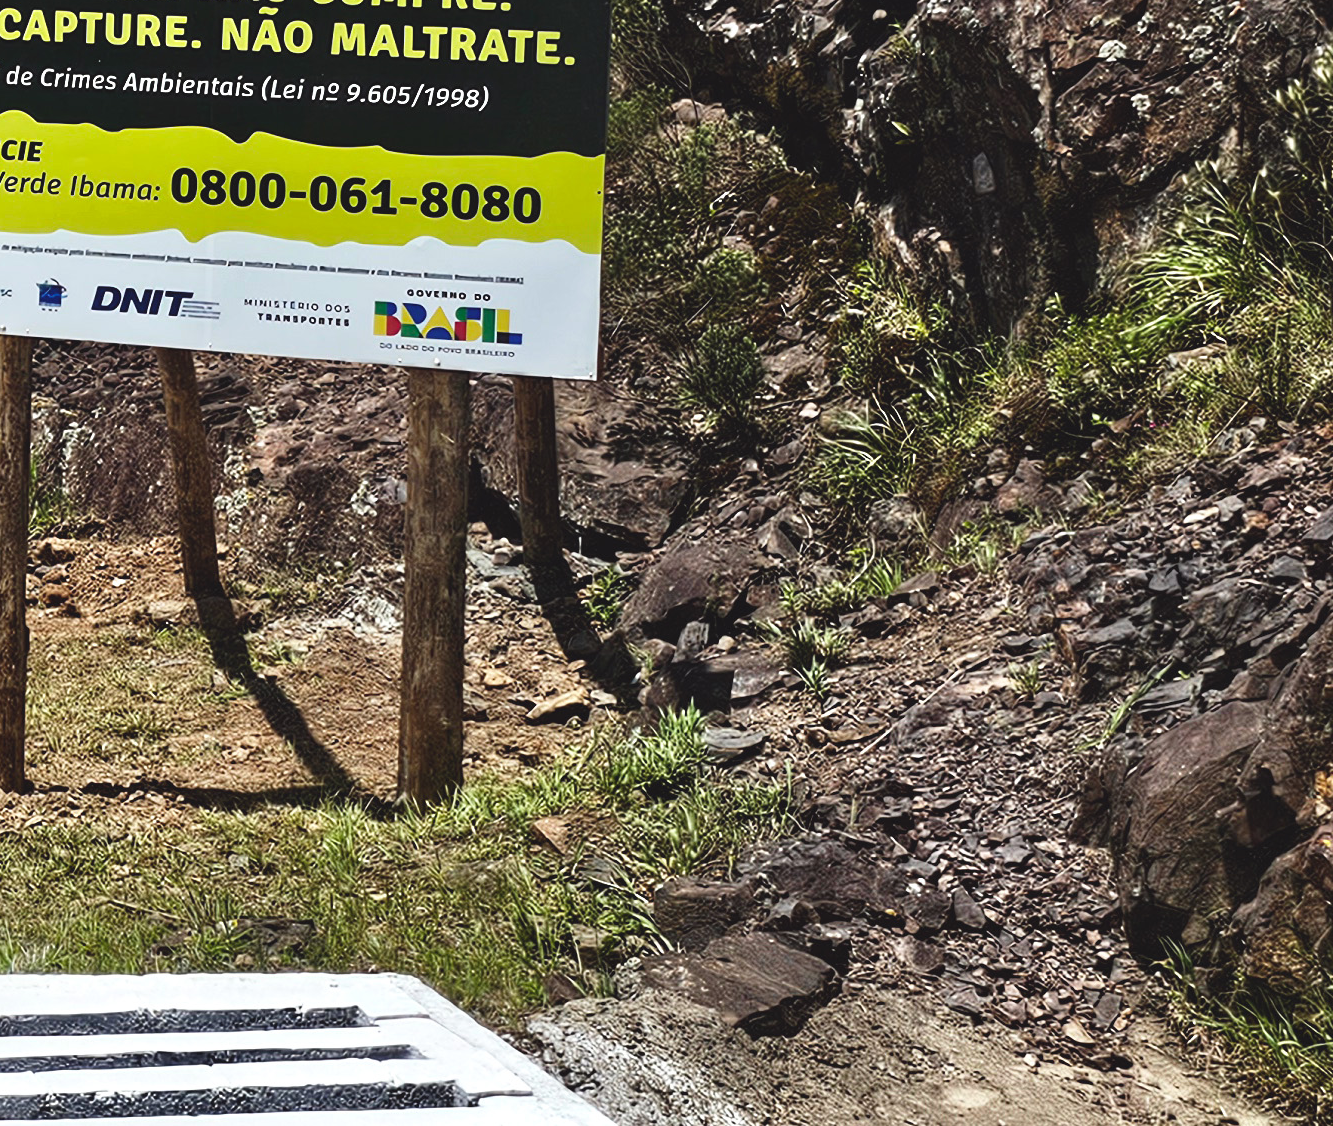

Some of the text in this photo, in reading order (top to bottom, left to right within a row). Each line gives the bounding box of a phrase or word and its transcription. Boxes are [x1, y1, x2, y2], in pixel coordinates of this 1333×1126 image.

[221, 8, 313, 54] NÃO
[331, 23, 576, 66] MALTRATE.
[7, 66, 33, 86] de
[40, 67, 116, 91] Crimes
[124, 72, 254, 98] Ambientais
[261, 77, 304, 102] (Lei
[347, 82, 490, 111] 9.605/1998)
[70, 175, 161, 200] Ibama:
[170, 168, 542, 224] 0800-061-8080
[91, 286, 194, 317] DNIT
[245, 298, 351, 313] MINISTÉRIO DOS
[407, 289, 491, 301] GOVERNO DO
[258, 313, 350, 326] TRANSPORTES
[373, 301, 523, 345] BRASIL
